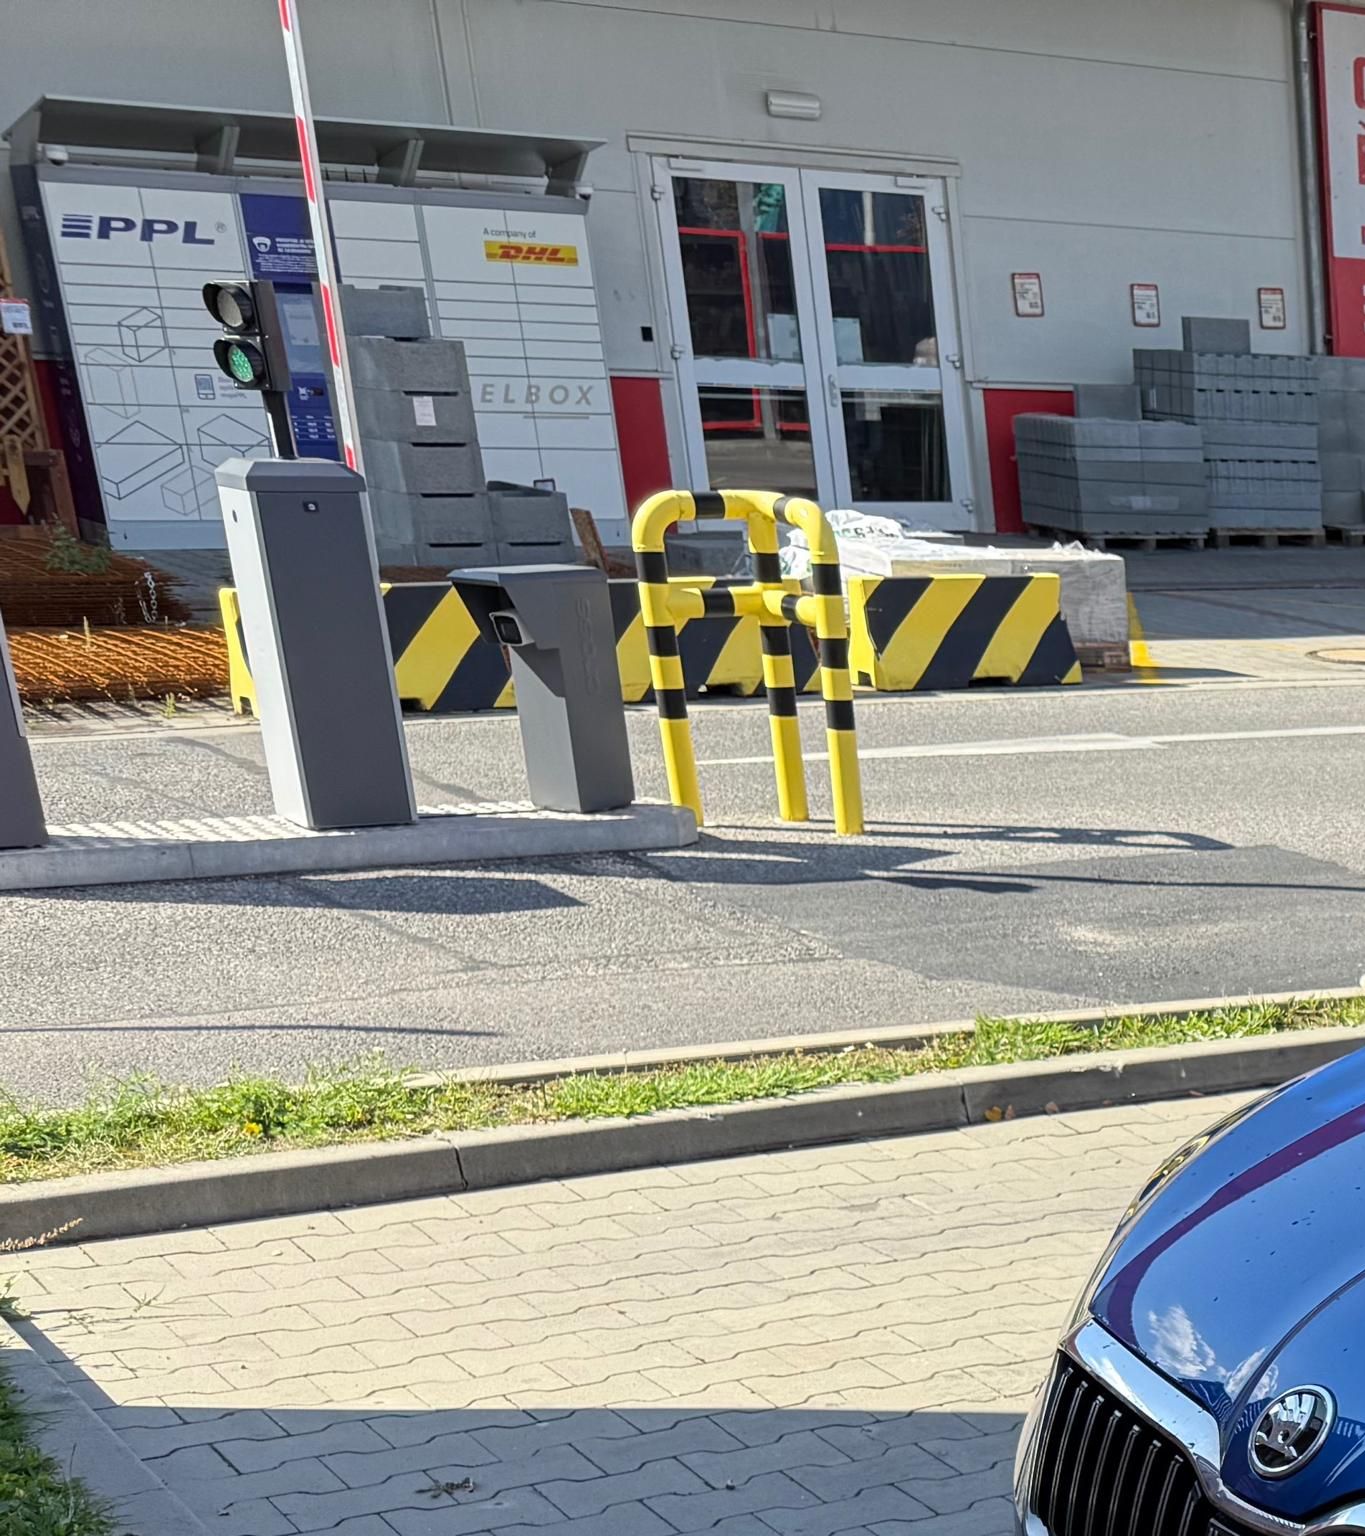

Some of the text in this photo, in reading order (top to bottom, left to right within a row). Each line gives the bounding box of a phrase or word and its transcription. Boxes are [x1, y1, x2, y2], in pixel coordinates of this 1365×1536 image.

[96, 215, 215, 246] PPL
[483, 227, 536, 239] A company of
[498, 244, 566, 263] DHL
